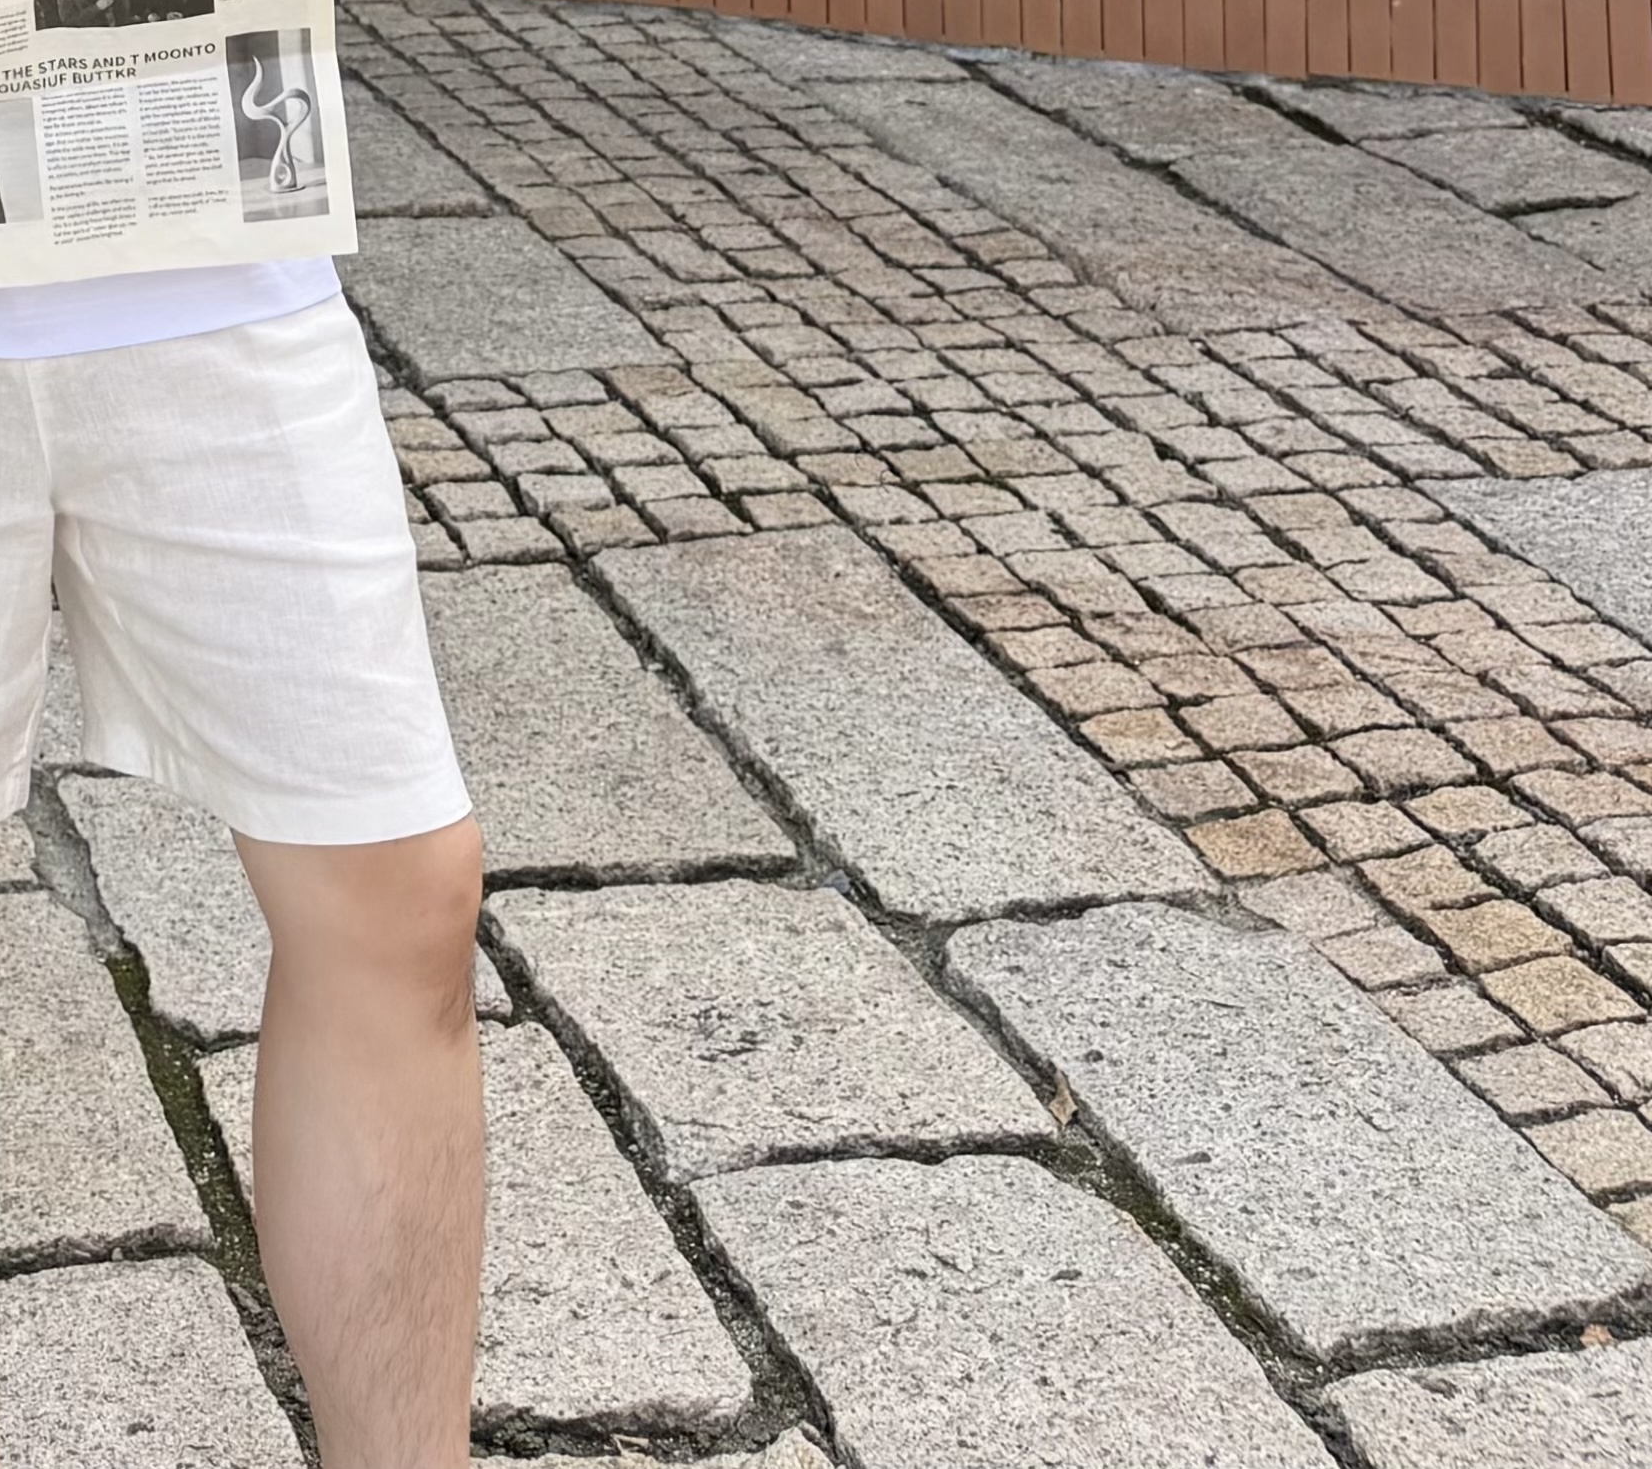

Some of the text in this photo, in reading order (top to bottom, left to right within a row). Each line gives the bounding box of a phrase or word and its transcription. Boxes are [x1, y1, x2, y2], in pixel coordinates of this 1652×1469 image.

[2, 64, 33, 82] THE
[38, 57, 88, 75] STARS
[92, 55, 126, 69] AND
[130, 54, 140, 64] T
[144, 43, 217, 63] MOONTO
[72, 67, 137, 84] BUTTKR
